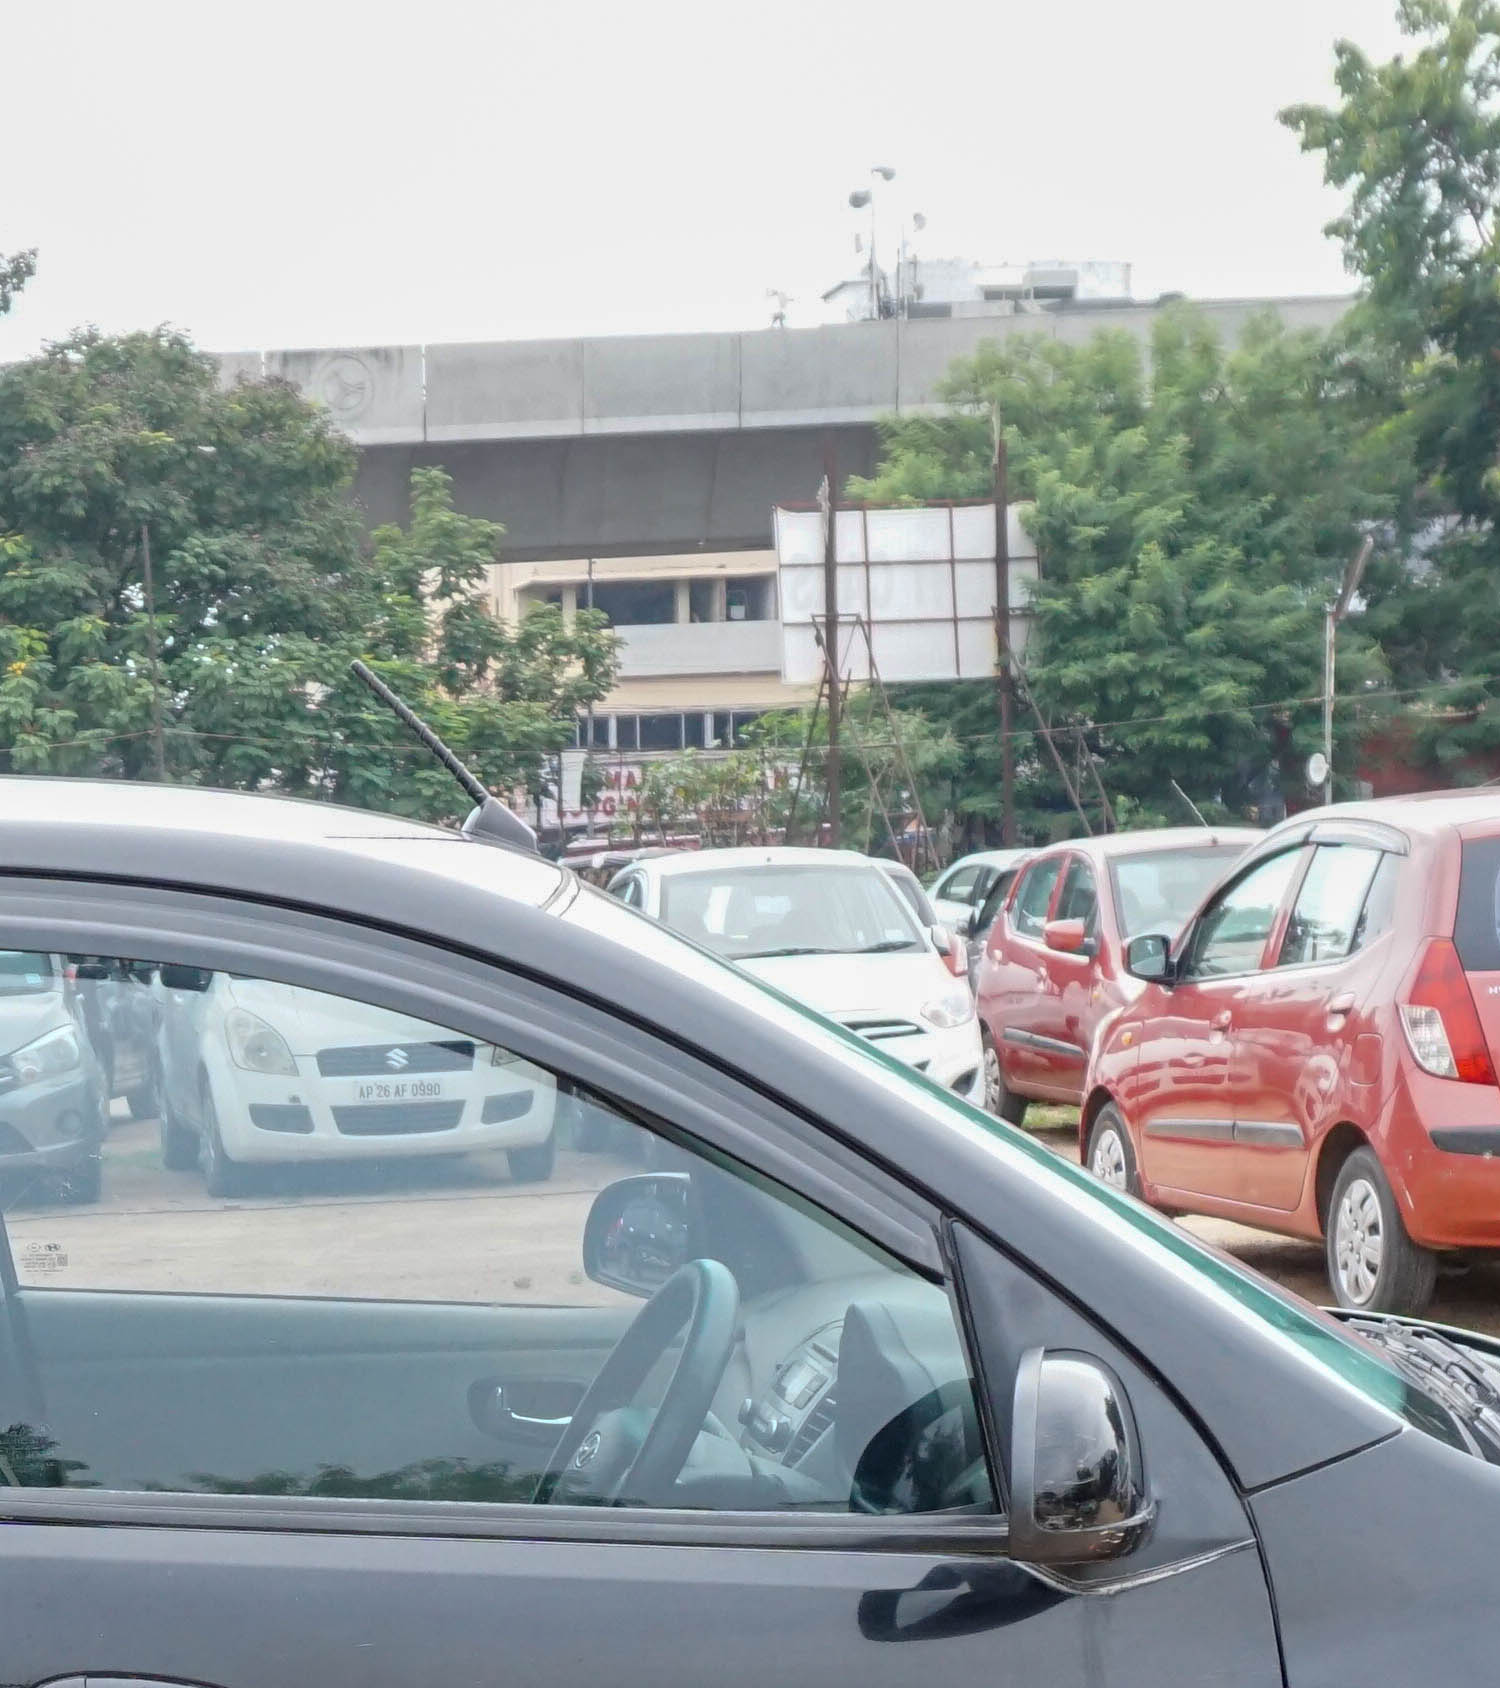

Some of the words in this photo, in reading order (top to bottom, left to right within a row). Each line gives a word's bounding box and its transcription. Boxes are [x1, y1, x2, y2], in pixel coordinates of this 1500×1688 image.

[359, 1086, 374, 1099] AP
[376, 1084, 391, 1098] 26
[394, 1083, 409, 1097] AF
[411, 1083, 441, 1097] 0990
